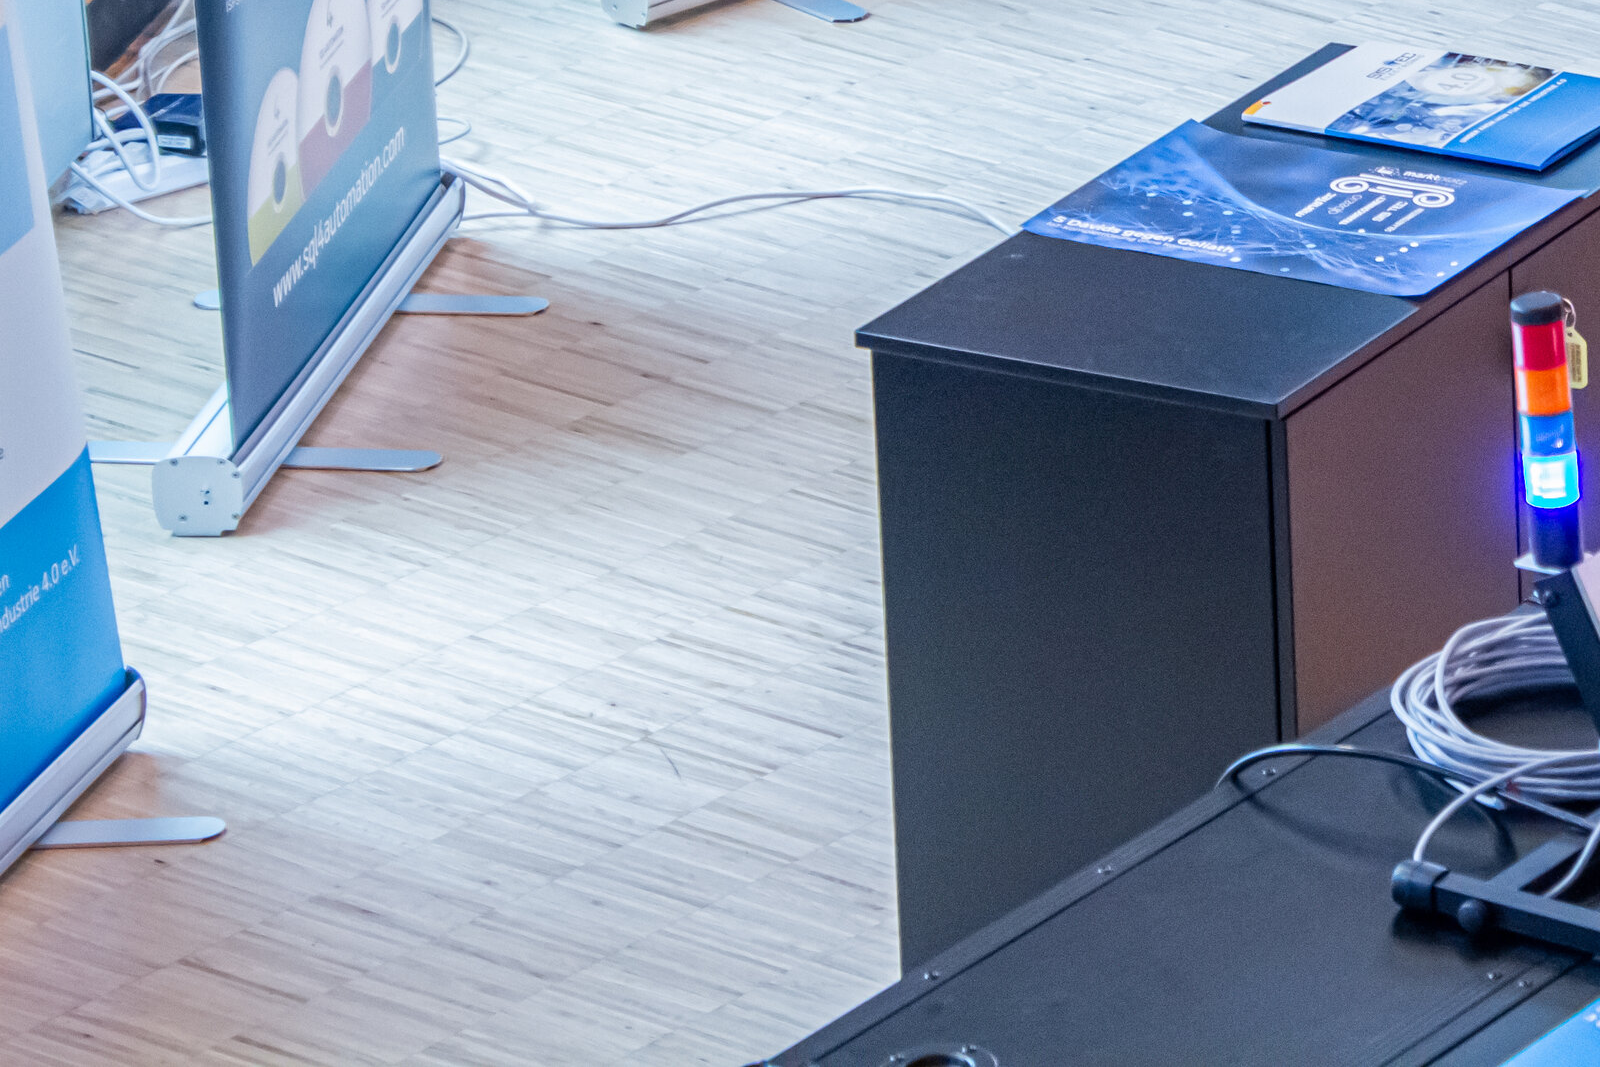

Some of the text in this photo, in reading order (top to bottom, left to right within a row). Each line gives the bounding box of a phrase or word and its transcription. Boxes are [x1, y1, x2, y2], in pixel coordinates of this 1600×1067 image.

[272, 126, 405, 309] www.sql4automation.com
[1066, 218, 1122, 234] Davids
[1121, 228, 1175, 244] gegen
[1177, 237, 1236, 254] Goliath
[41, 561, 60, 592] 4.0
